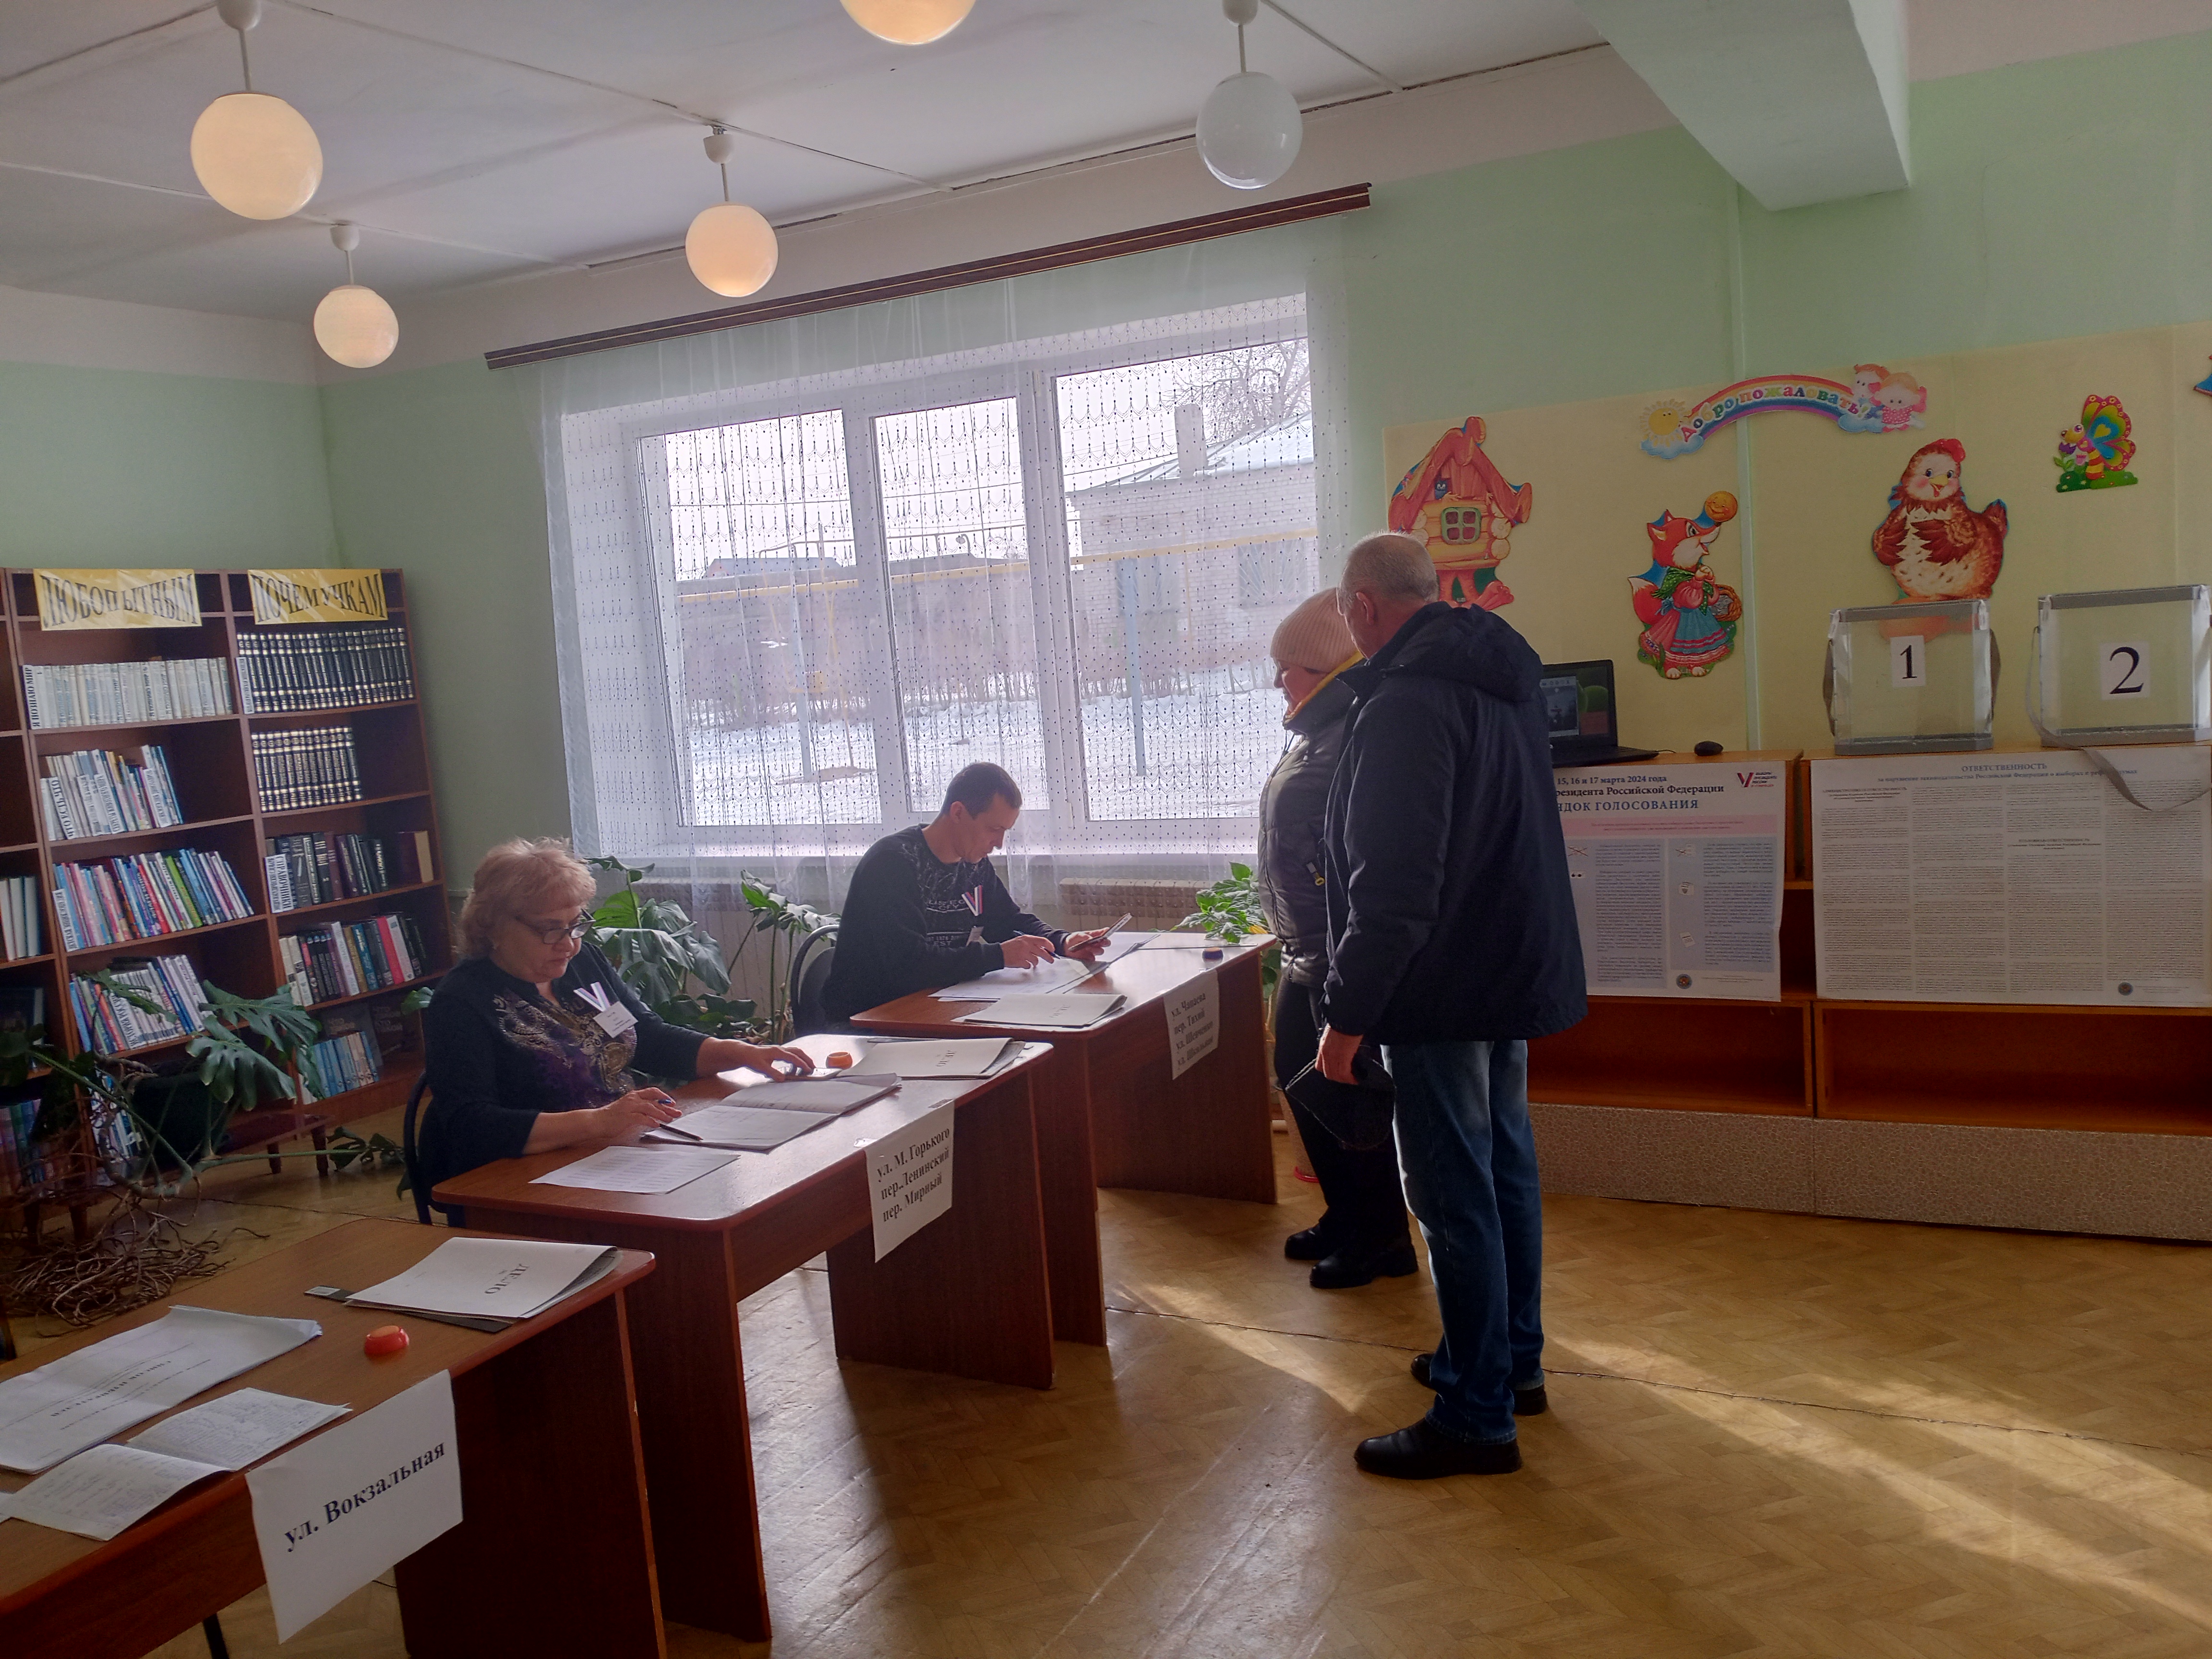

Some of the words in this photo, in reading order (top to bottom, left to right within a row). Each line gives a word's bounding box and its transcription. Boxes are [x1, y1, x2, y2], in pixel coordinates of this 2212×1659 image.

[1681, 398, 1735, 443] Добро
[40, 574, 198, 628] ЛЮБОПЫТНЫМ
[250, 574, 386, 622] ПОЧЕМУЧКАМ
[25, 667, 34, 685] МИР
[1900, 644, 1917, 679] 1
[2109, 646, 2144, 695] 2
[28, 686, 39, 720] ПОЗНАЮ
[1606, 786, 1665, 795] Российской
[1667, 784, 1724, 795] Федерации
[1961, 763, 2047, 772] ОТВЕТСТВЕННОСТЬ
[1558, 802, 1591, 813] ЯДОК
[1595, 799, 1699, 811] ГОЛОСОВАНИЯ
[276, 856, 292, 909] СПРАВОЧНИКИ
[877, 1163, 893, 1183] ул.
[894, 1151, 908, 1169] М.
[909, 1128, 950, 1161] Горького
[882, 1204, 902, 1222] пер.
[904, 1172, 943, 1208] Мирный
[484, 1263, 529, 1294] ДЕЛО
[284, 1520, 319, 1553] ул.
[323, 1442, 445, 1525] Вокзальная
